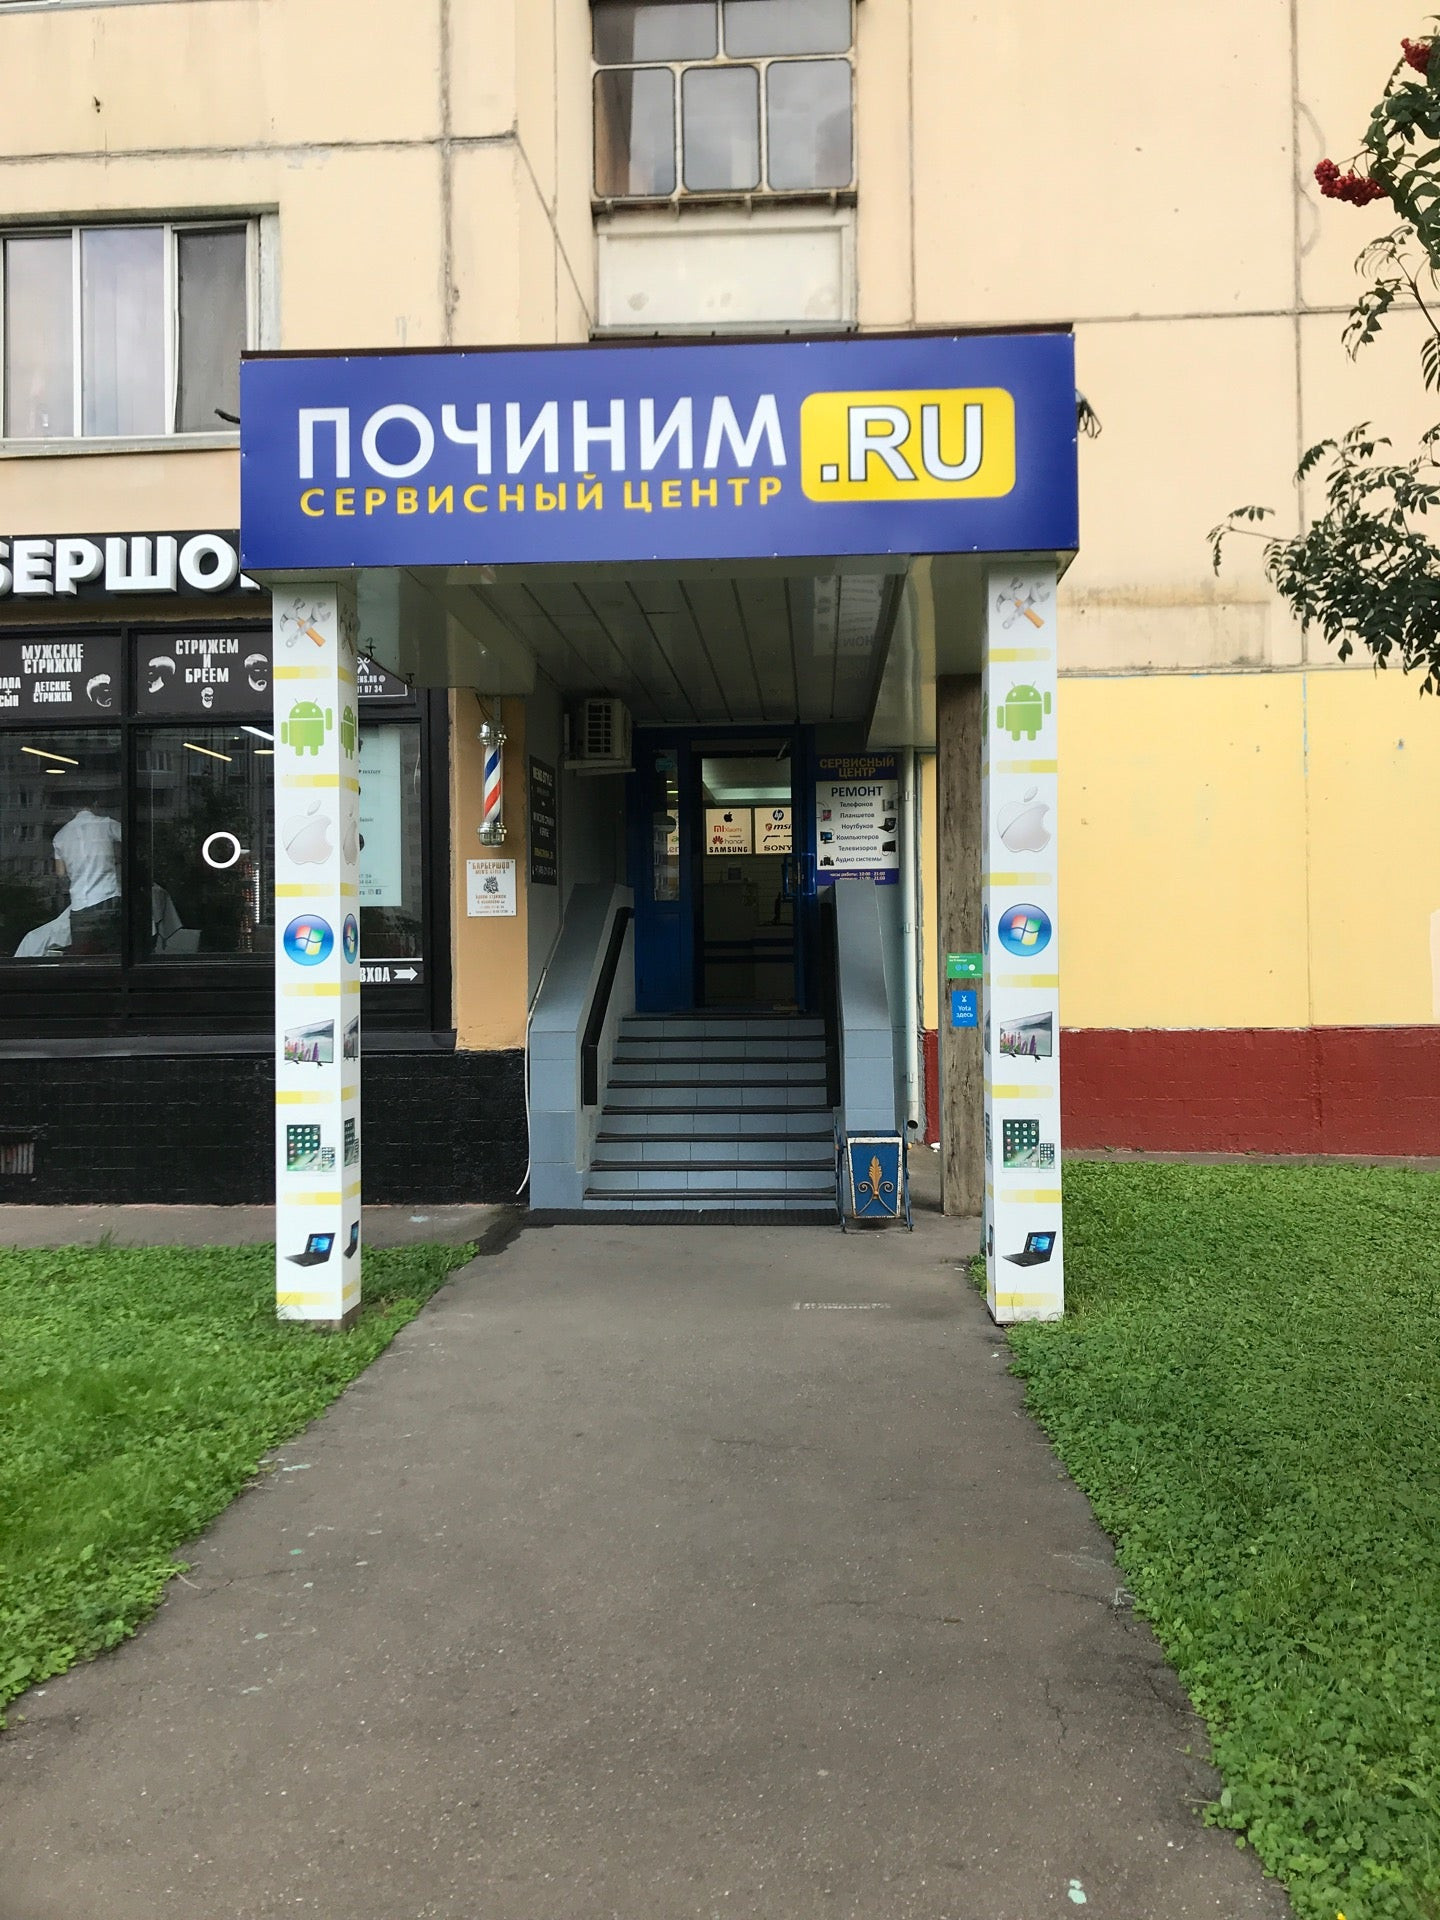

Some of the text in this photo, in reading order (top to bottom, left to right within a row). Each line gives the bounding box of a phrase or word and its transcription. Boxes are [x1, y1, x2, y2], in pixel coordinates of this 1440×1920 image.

[298, 394, 984, 483] ПОЧИНИМ .RU
[299, 473, 783, 517] СЕРВИСНЫЙ ЦЕНТР
[0, 533, 261, 597] ЕРШО
[21, 643, 84, 660] МУЖСКИЕ
[175, 638, 240, 655] СТРИЖЕМ
[24, 658, 82, 674] СТРИЖКИ
[203, 653, 212, 668] И
[185, 667, 230, 683] БРЕЕМ
[35, 680, 71, 694] ДЕТСКИЕ
[374, 684, 383, 693] 34
[33, 691, 72, 703] СТРИЖКИ
[819, 755, 895, 769] СЕРВИСНЫЙ
[838, 767, 876, 779] ЦЕНТР
[831, 786, 884, 797] РЕМОНТ
[956, 1012, 974, 1020] здесь
